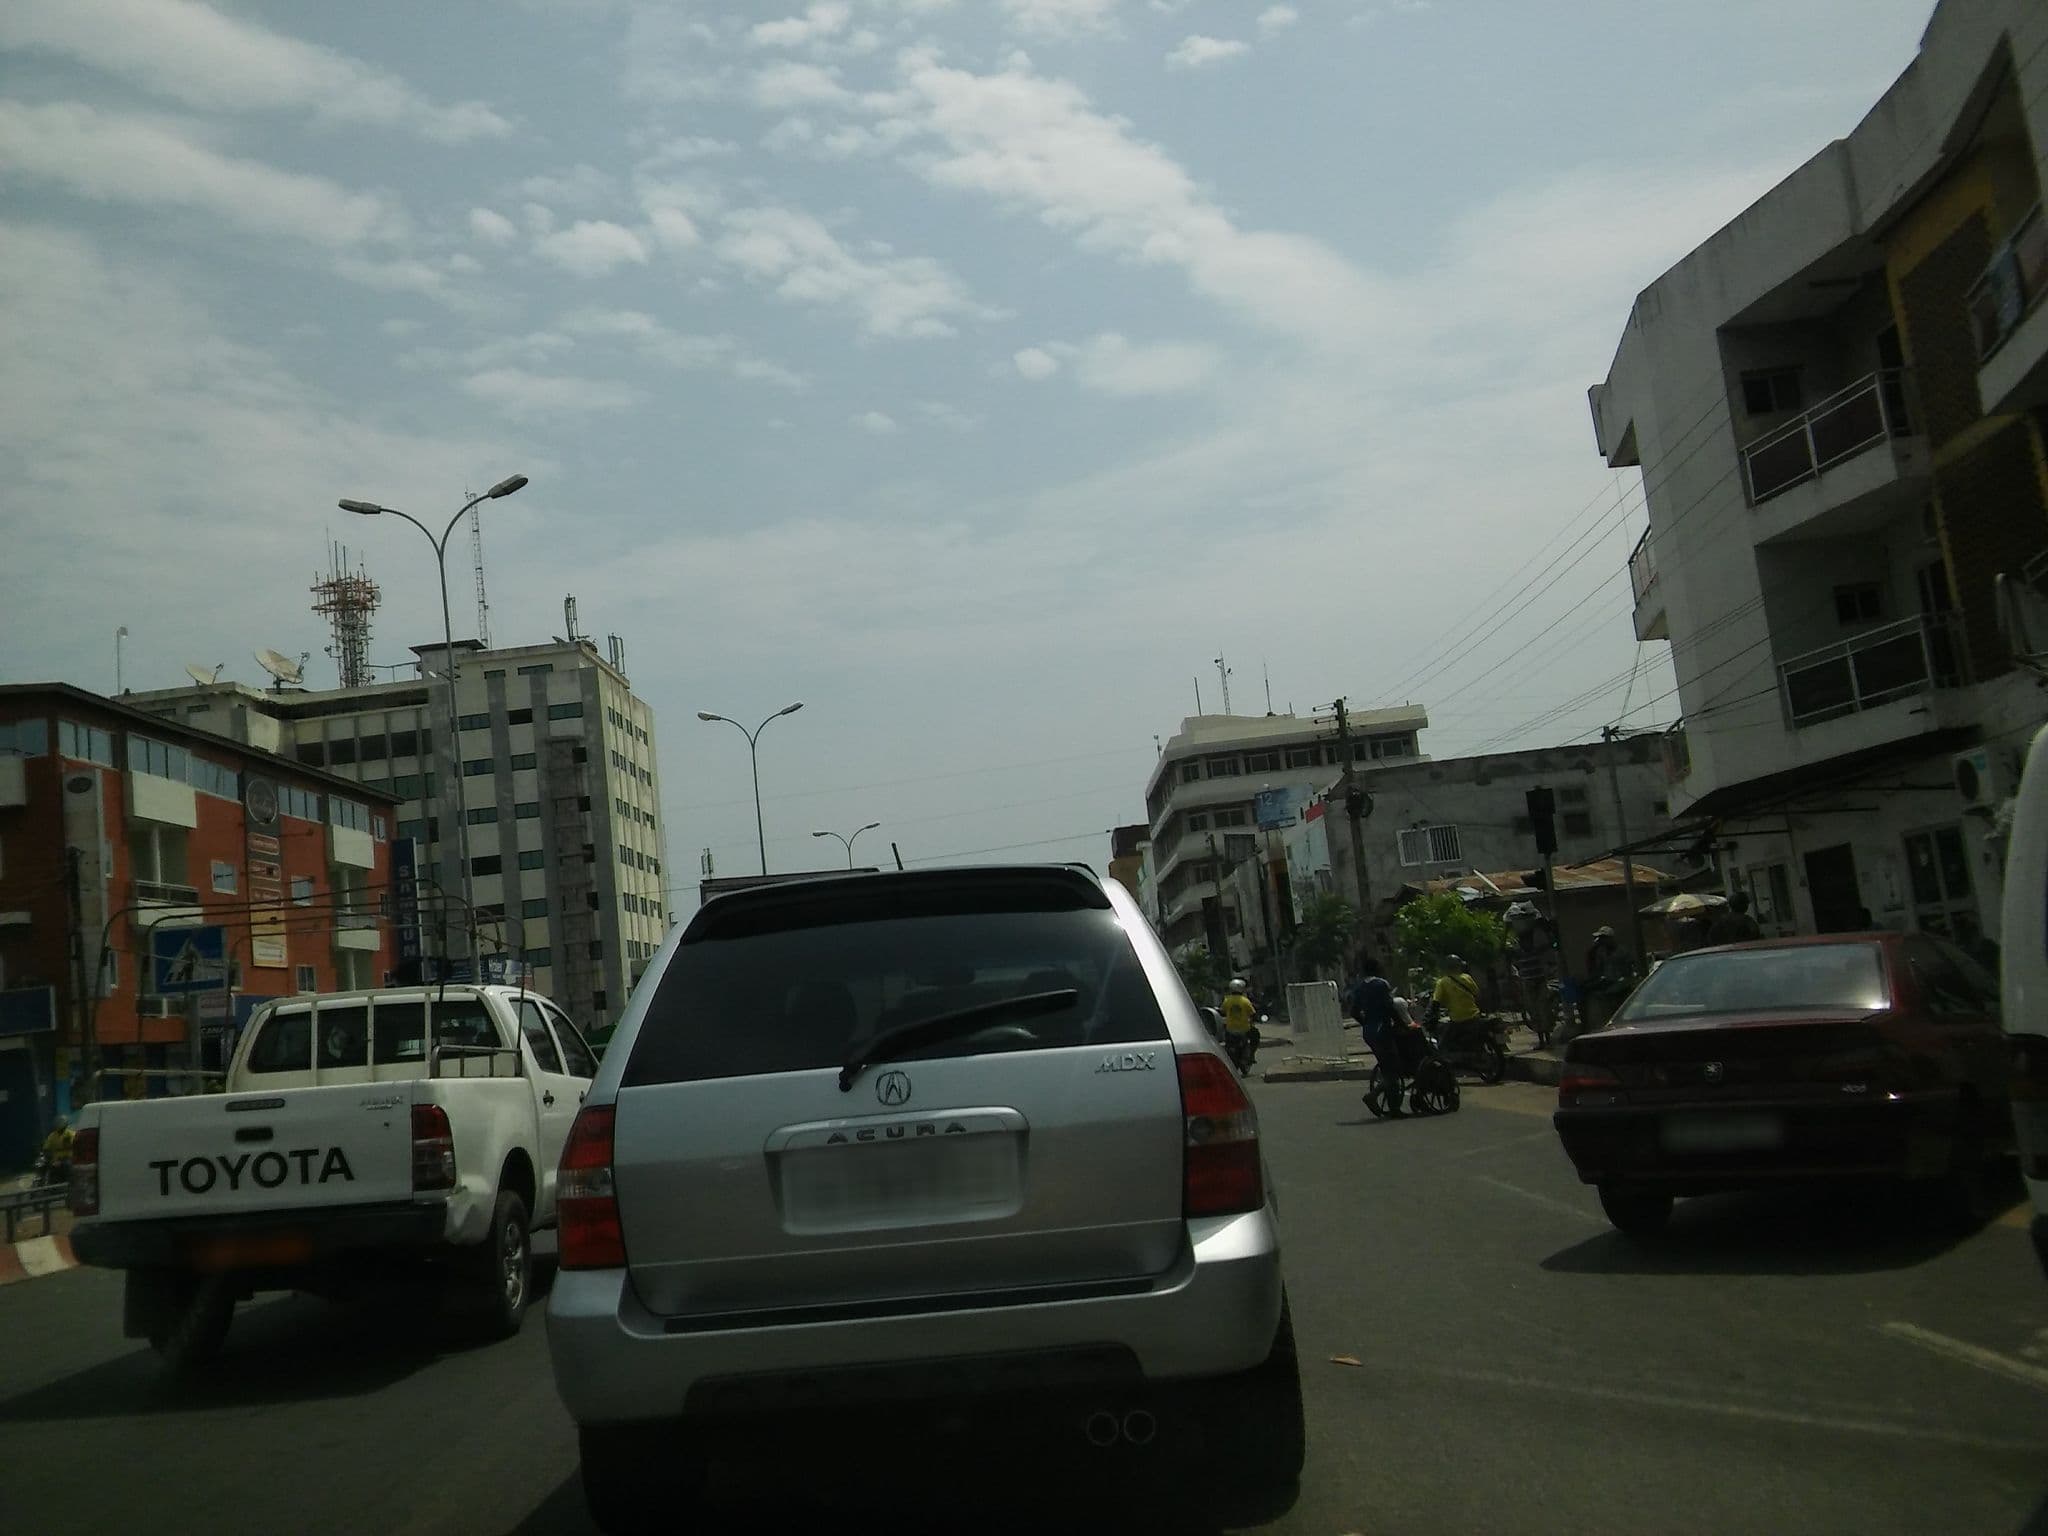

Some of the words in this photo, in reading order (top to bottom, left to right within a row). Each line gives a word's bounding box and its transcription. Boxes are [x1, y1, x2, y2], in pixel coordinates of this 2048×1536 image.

[399, 864, 417, 957] SAMSUN
[1095, 1052, 1156, 1073] MDX
[827, 1123, 967, 1144] ACURA
[149, 1147, 355, 1196] TOYOTA
